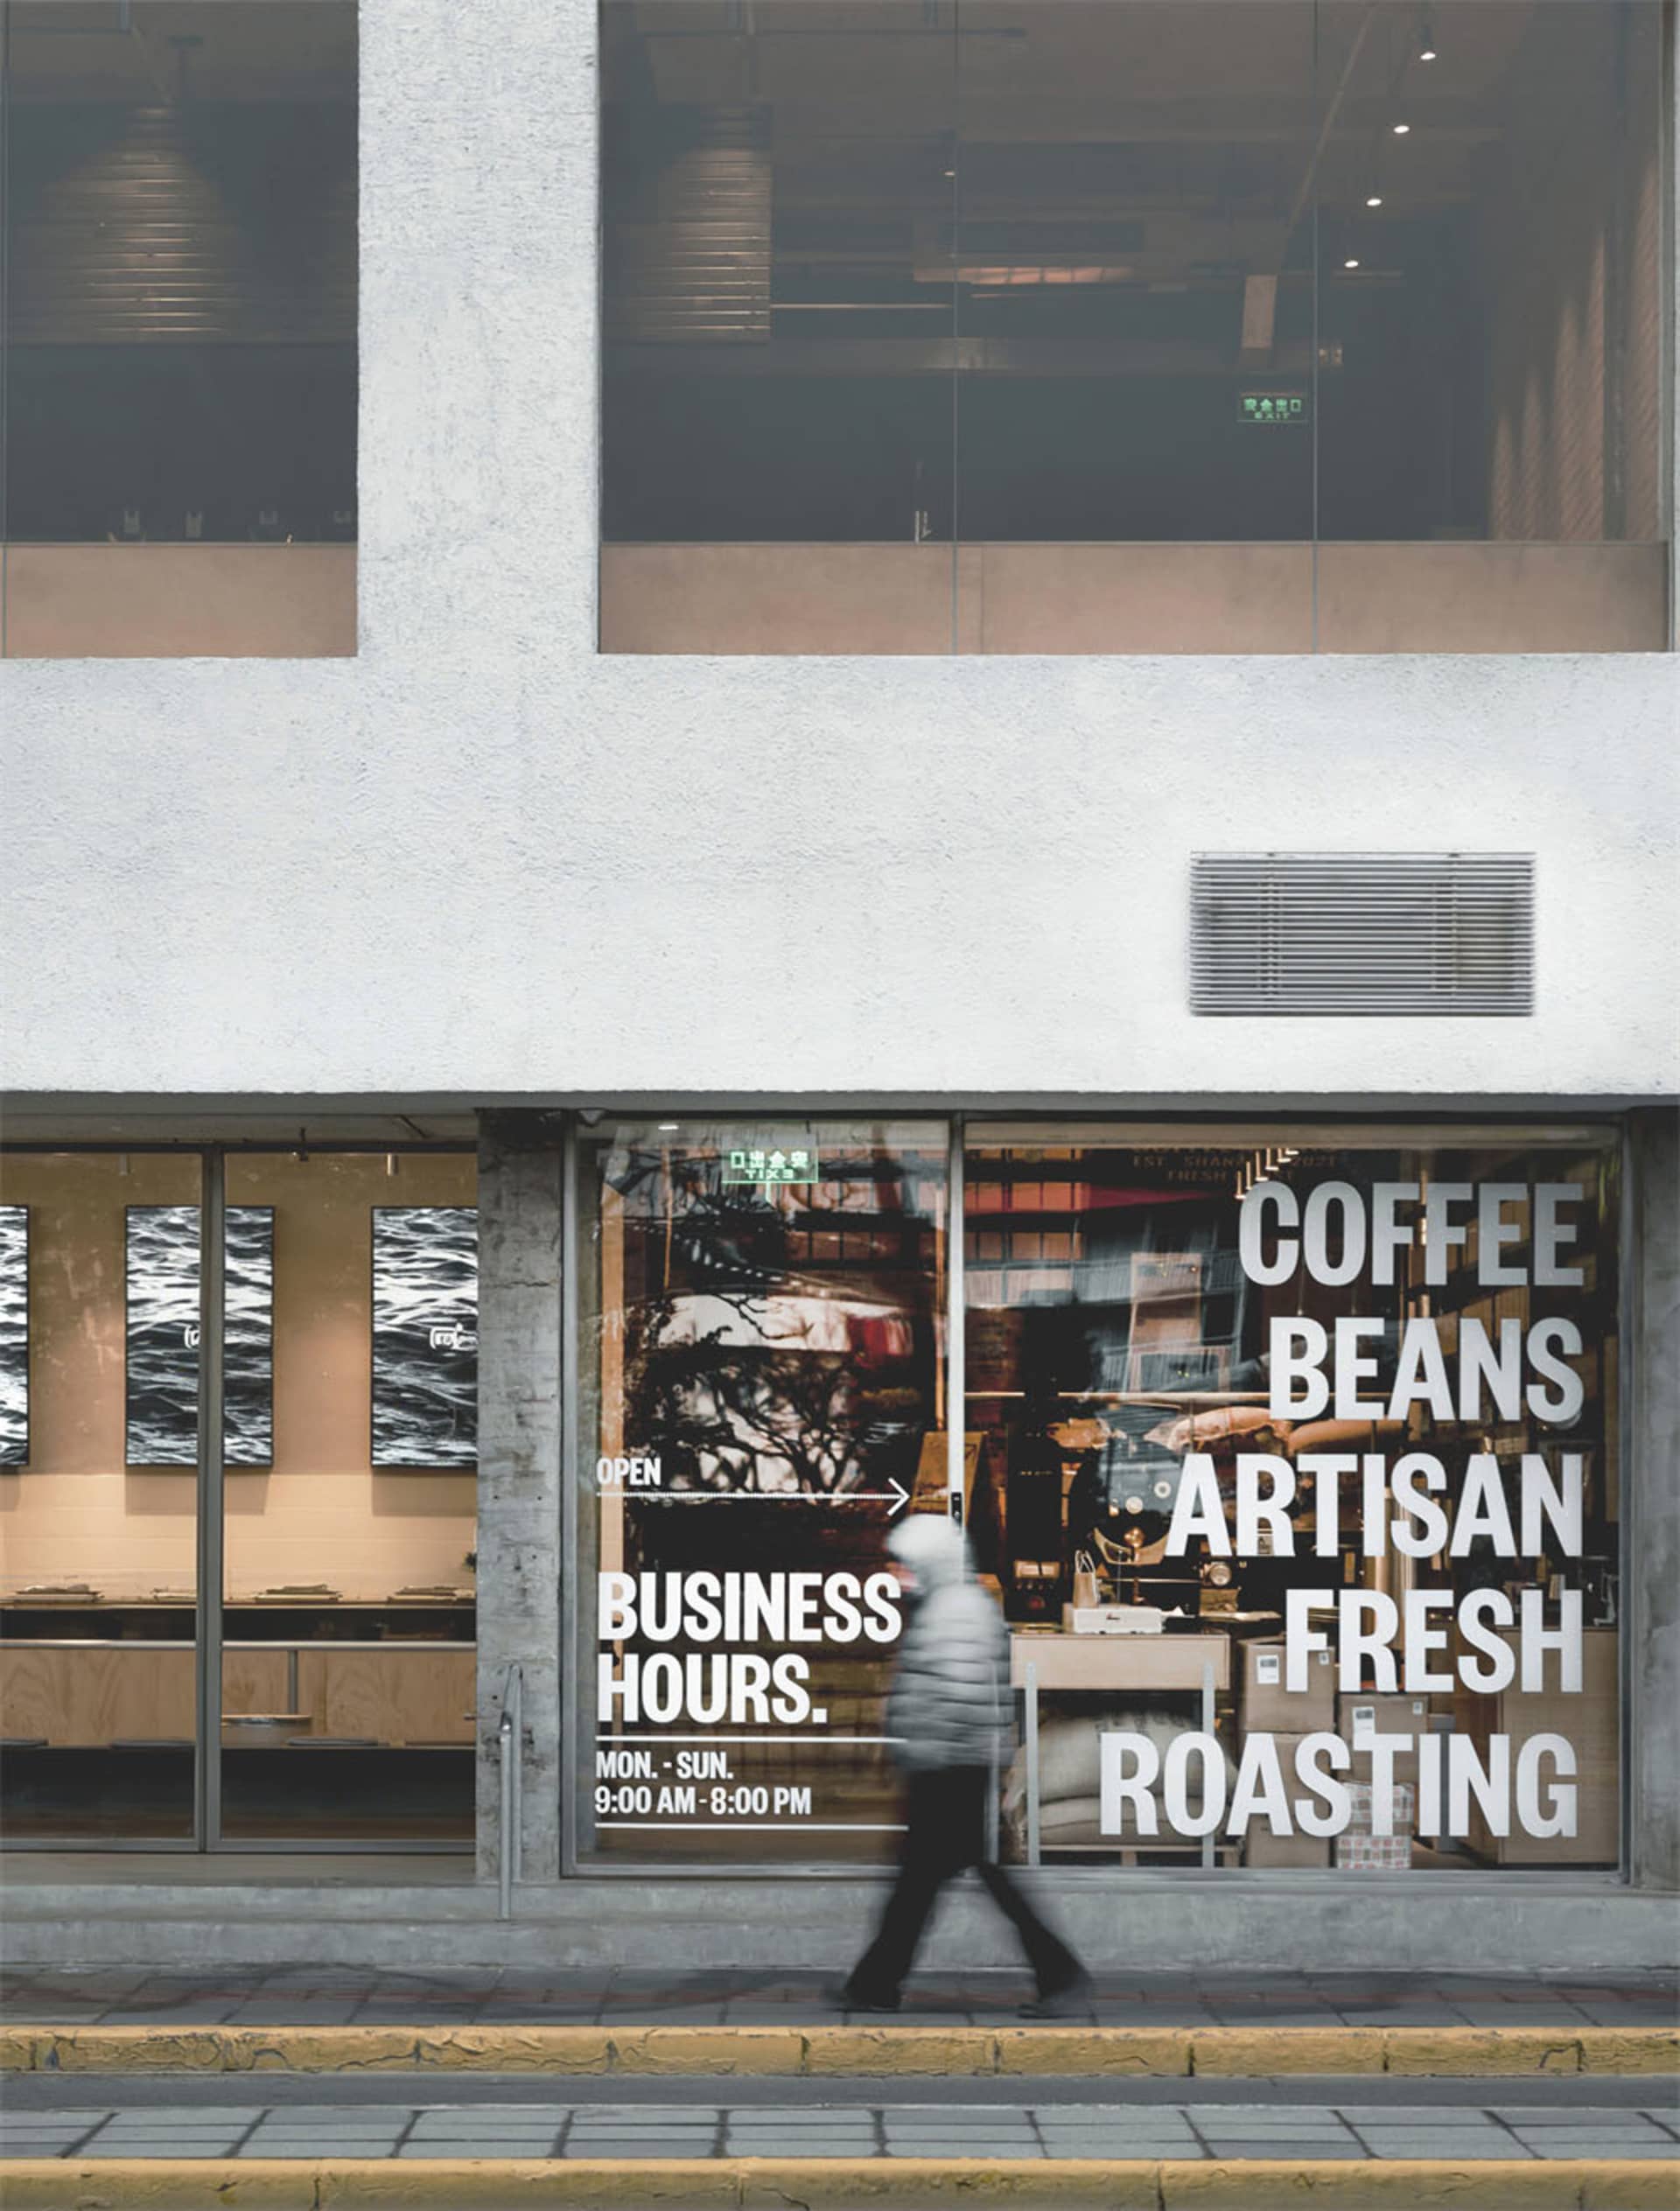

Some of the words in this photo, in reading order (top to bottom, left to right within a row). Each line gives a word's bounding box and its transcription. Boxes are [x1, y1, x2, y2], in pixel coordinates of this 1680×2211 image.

[1239, 1181, 1585, 1286] COFFEE
[1270, 1317, 1584, 1422] BEANS
[597, 1457, 661, 1486] OPEN
[1165, 1453, 1583, 1557] ARTISAN
[598, 1571, 902, 1642] BUSINESS
[1285, 1589, 1583, 1693] FRESH
[598, 1653, 828, 1724] HOURS.
[594, 1786, 652, 1814] 9:00
[774, 1787, 811, 1815] PM
[596, 1751, 658, 1779] MON.
[676, 1751, 733, 1779] SUN.
[1100, 1732, 1578, 1837] ROASTING
